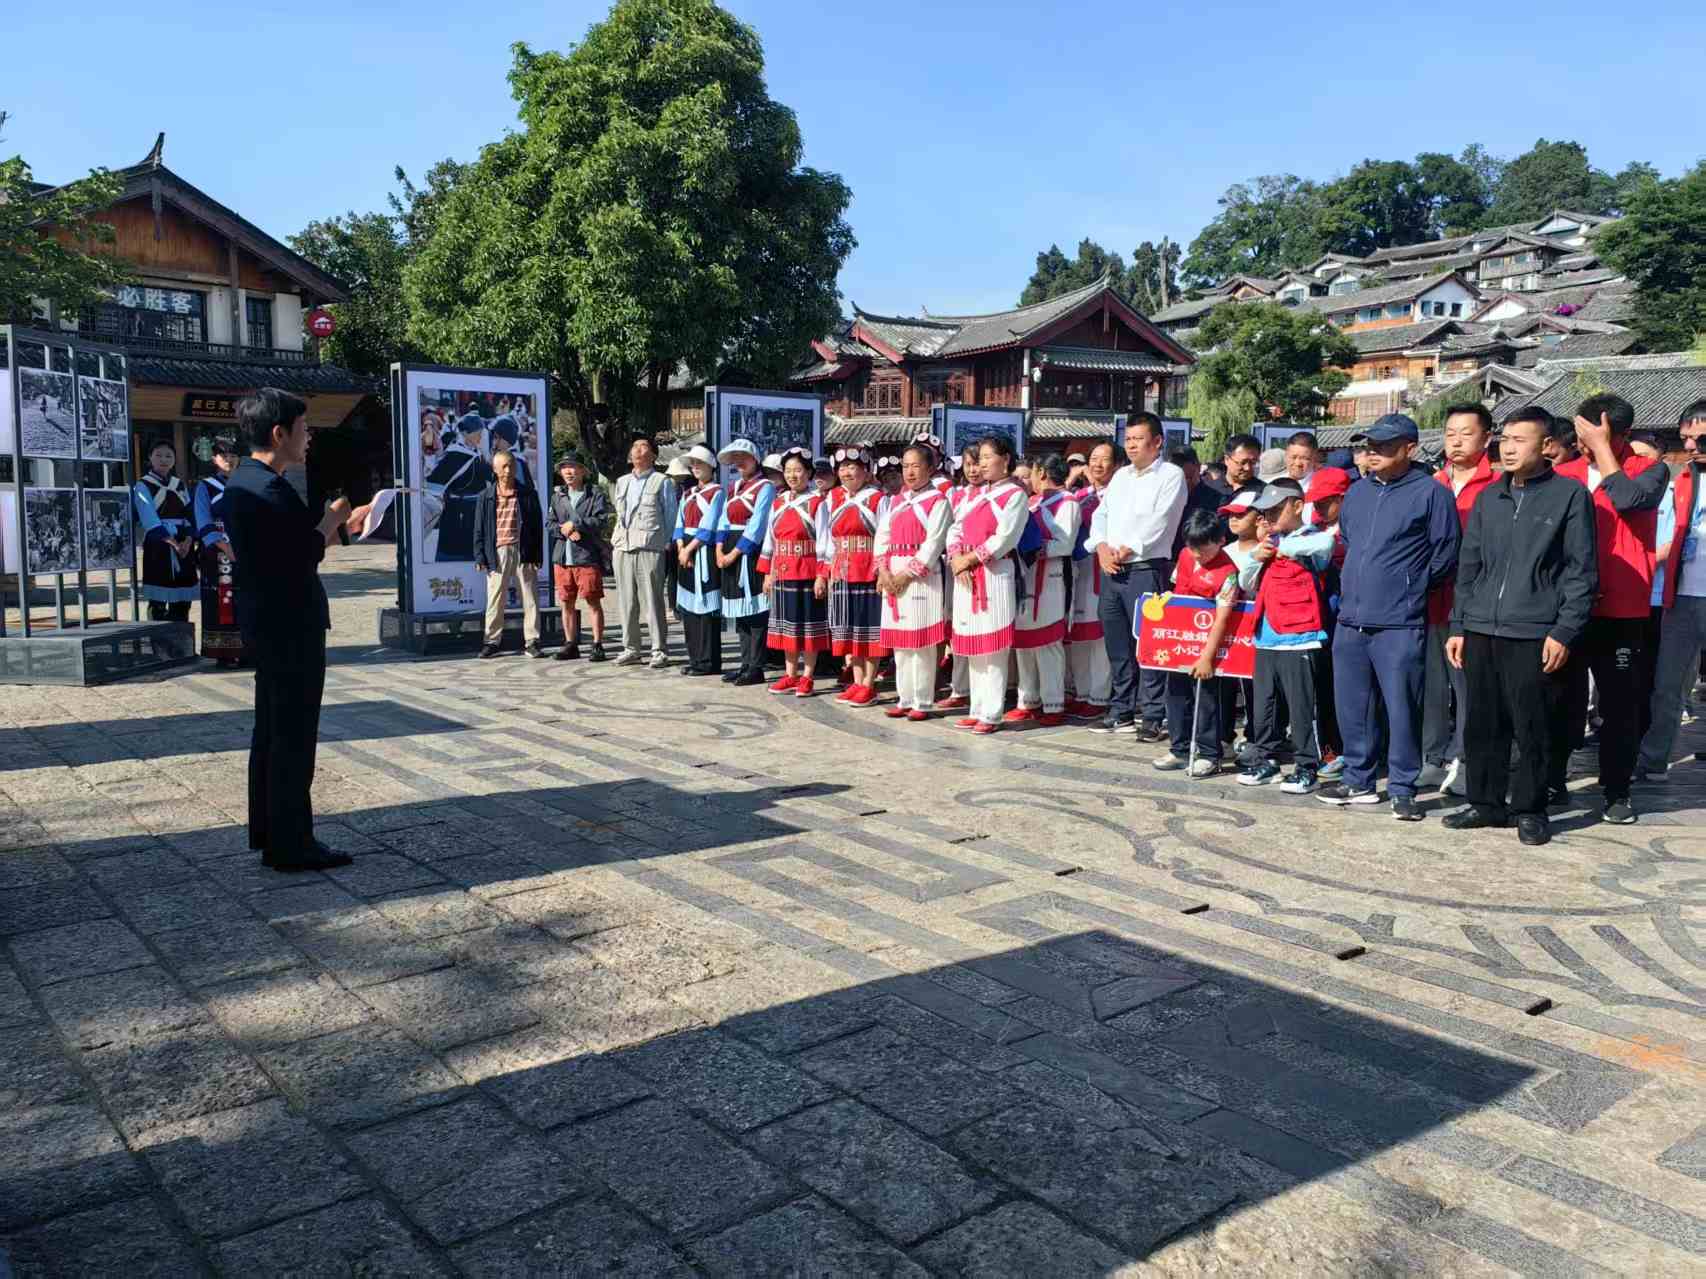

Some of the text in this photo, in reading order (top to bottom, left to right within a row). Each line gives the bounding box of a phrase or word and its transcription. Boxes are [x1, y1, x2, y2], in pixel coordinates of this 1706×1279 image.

[117, 286, 192, 314] 必胜客
[1152, 627, 1252, 646] 丽江融媒中心
[1172, 644, 1228, 659] 小记团
